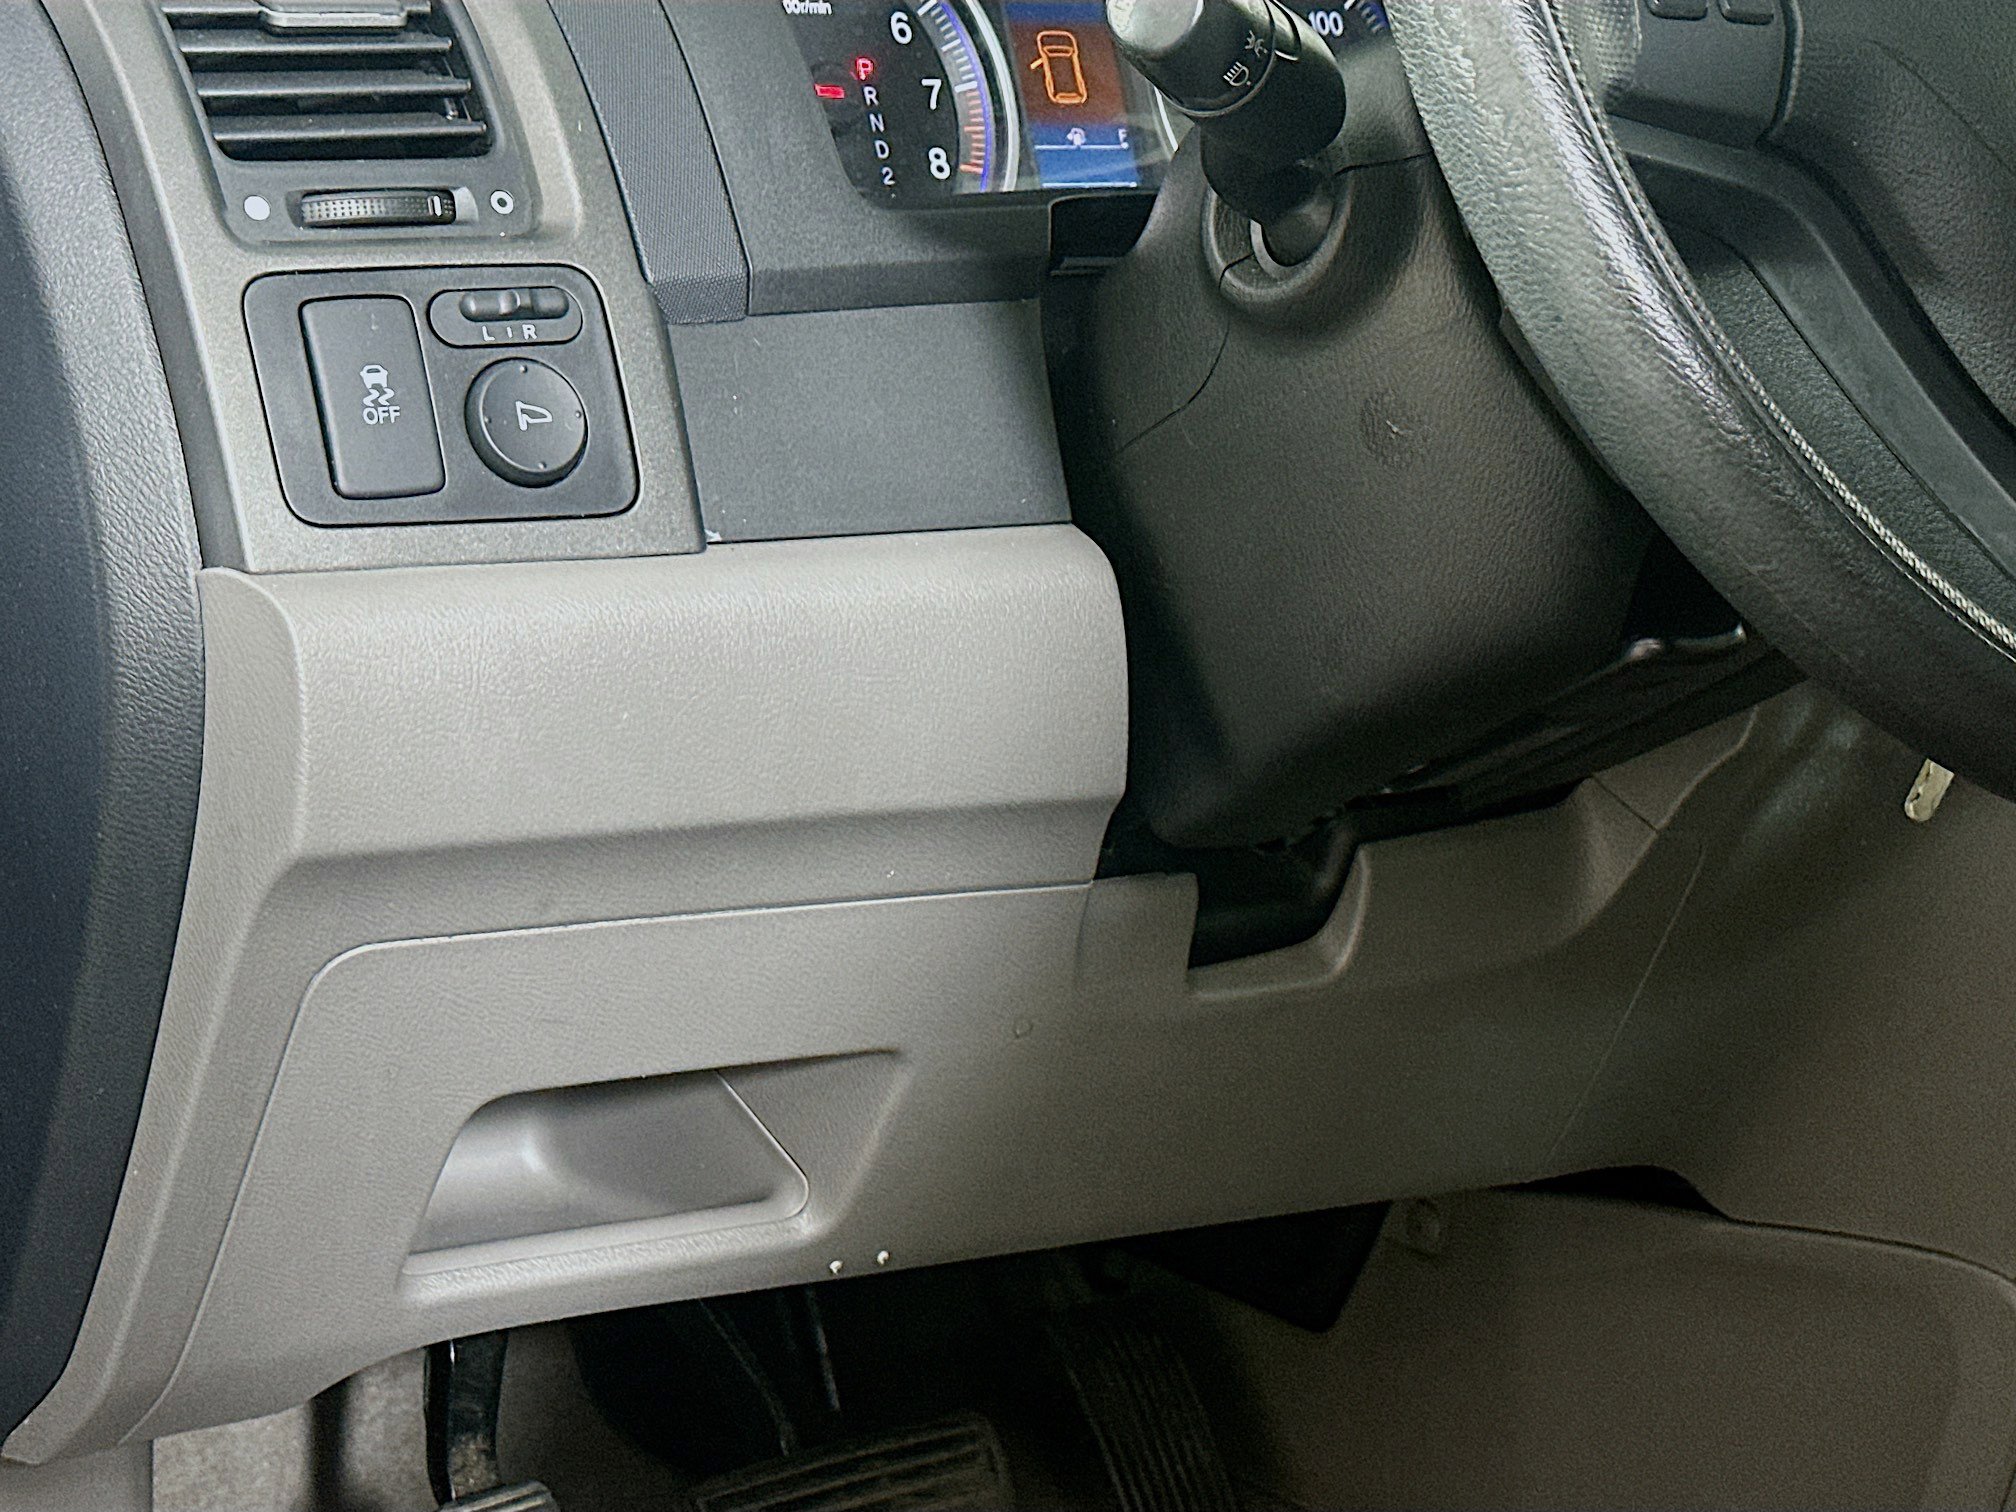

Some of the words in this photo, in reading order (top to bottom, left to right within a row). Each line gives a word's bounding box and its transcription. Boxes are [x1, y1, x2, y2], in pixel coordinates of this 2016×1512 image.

[890, 11, 913, 45] 6
[1308, 10, 1344, 37] 100
[855, 57, 874, 81] P
[863, 85, 879, 106] R
[921, 78, 942, 110] 7
[869, 113, 885, 133] N
[874, 139, 890, 160] D
[928, 146, 951, 180] 8
[881, 166, 896, 186] 2
[482, 325, 496, 341] L
[522, 324, 538, 340] R
[362, 405, 401, 425] OFF
